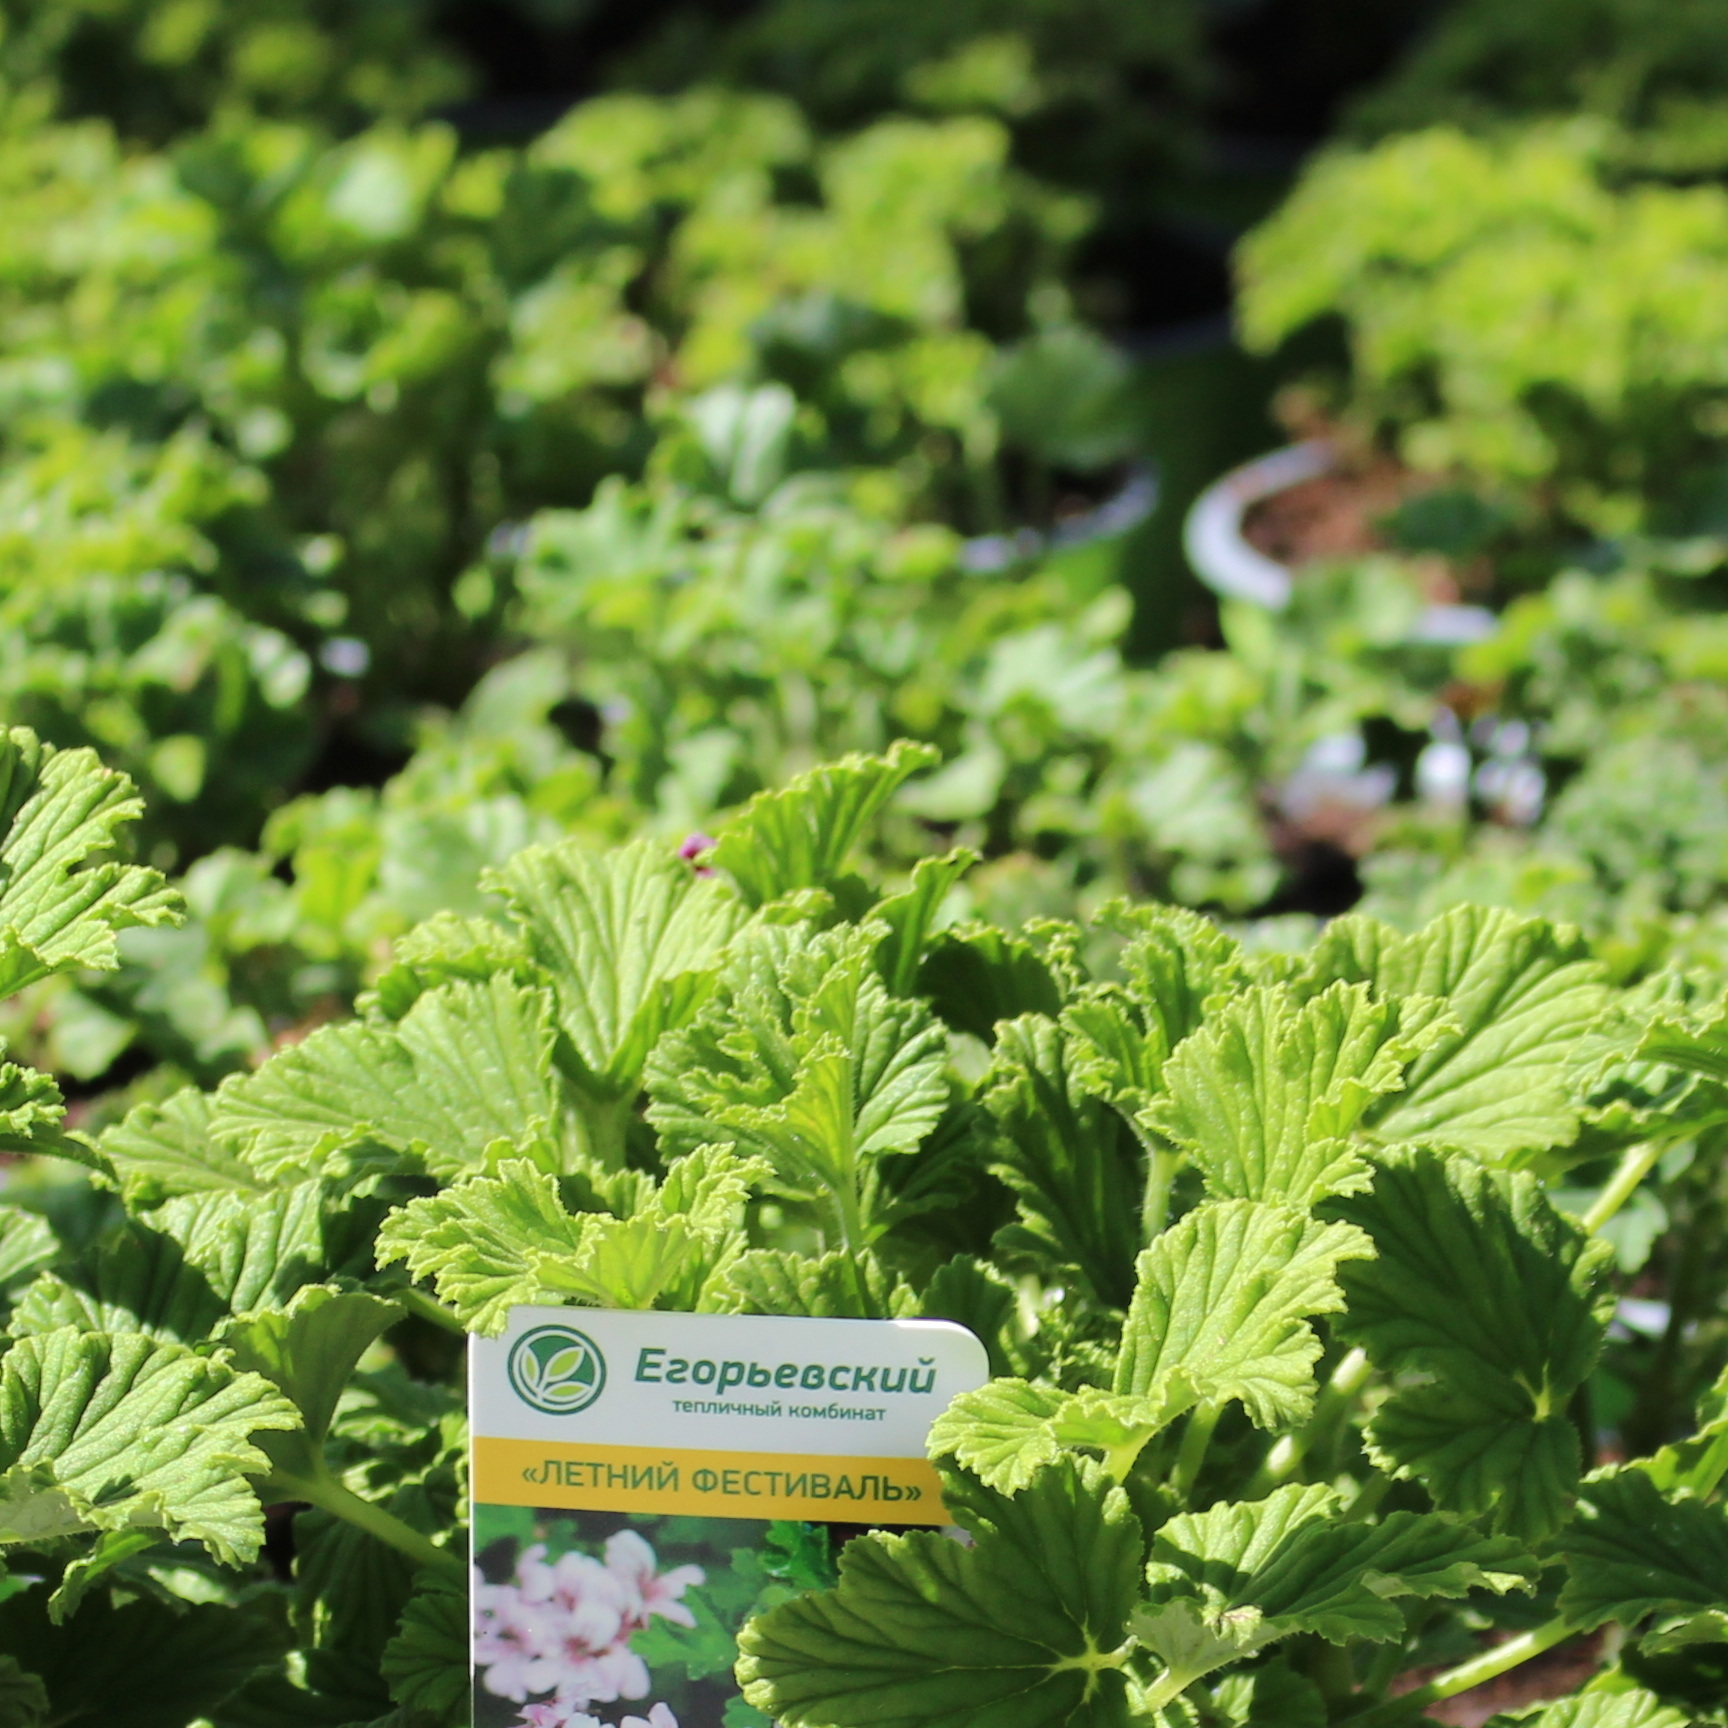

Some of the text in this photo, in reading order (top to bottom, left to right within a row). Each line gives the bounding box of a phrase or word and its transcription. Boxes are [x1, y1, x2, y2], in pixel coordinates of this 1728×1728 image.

[634, 1346, 937, 1395] Егорьевский
[673, 1399, 886, 1422] тепличный комбинат
[522, 1459, 922, 1502] «ЛЕТНИЙ ФЕСТИВАЛЬ»
